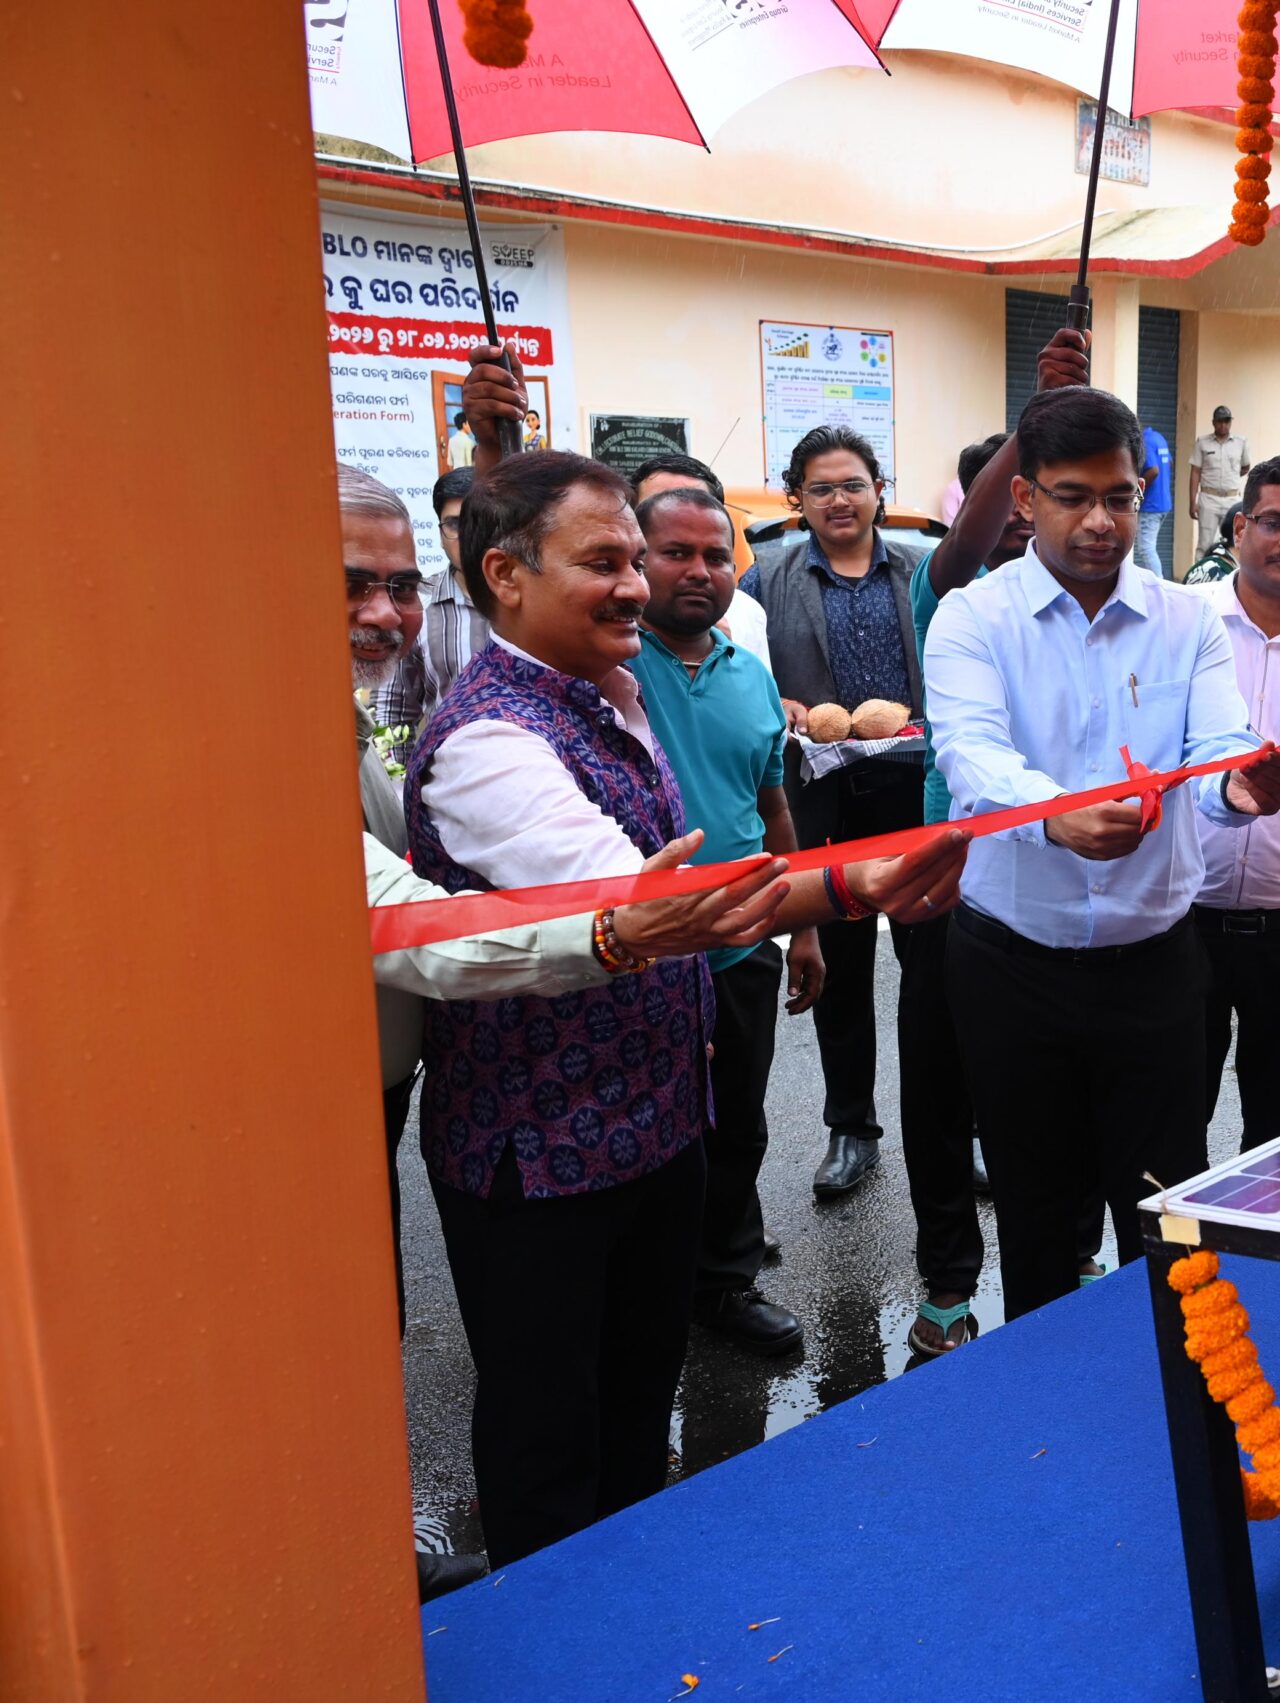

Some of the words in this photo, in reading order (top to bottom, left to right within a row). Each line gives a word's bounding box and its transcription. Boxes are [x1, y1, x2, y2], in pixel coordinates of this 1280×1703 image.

[322, 232, 368, 258] BLO
[373, 239, 433, 265] ମାନଙ୍କ
[492, 244, 535, 260] SWEEP
[340, 275, 363, 310] କୁ
[370, 278, 412, 304] ଘର
[333, 408, 377, 420] eration
[380, 410, 415, 424] Form)
